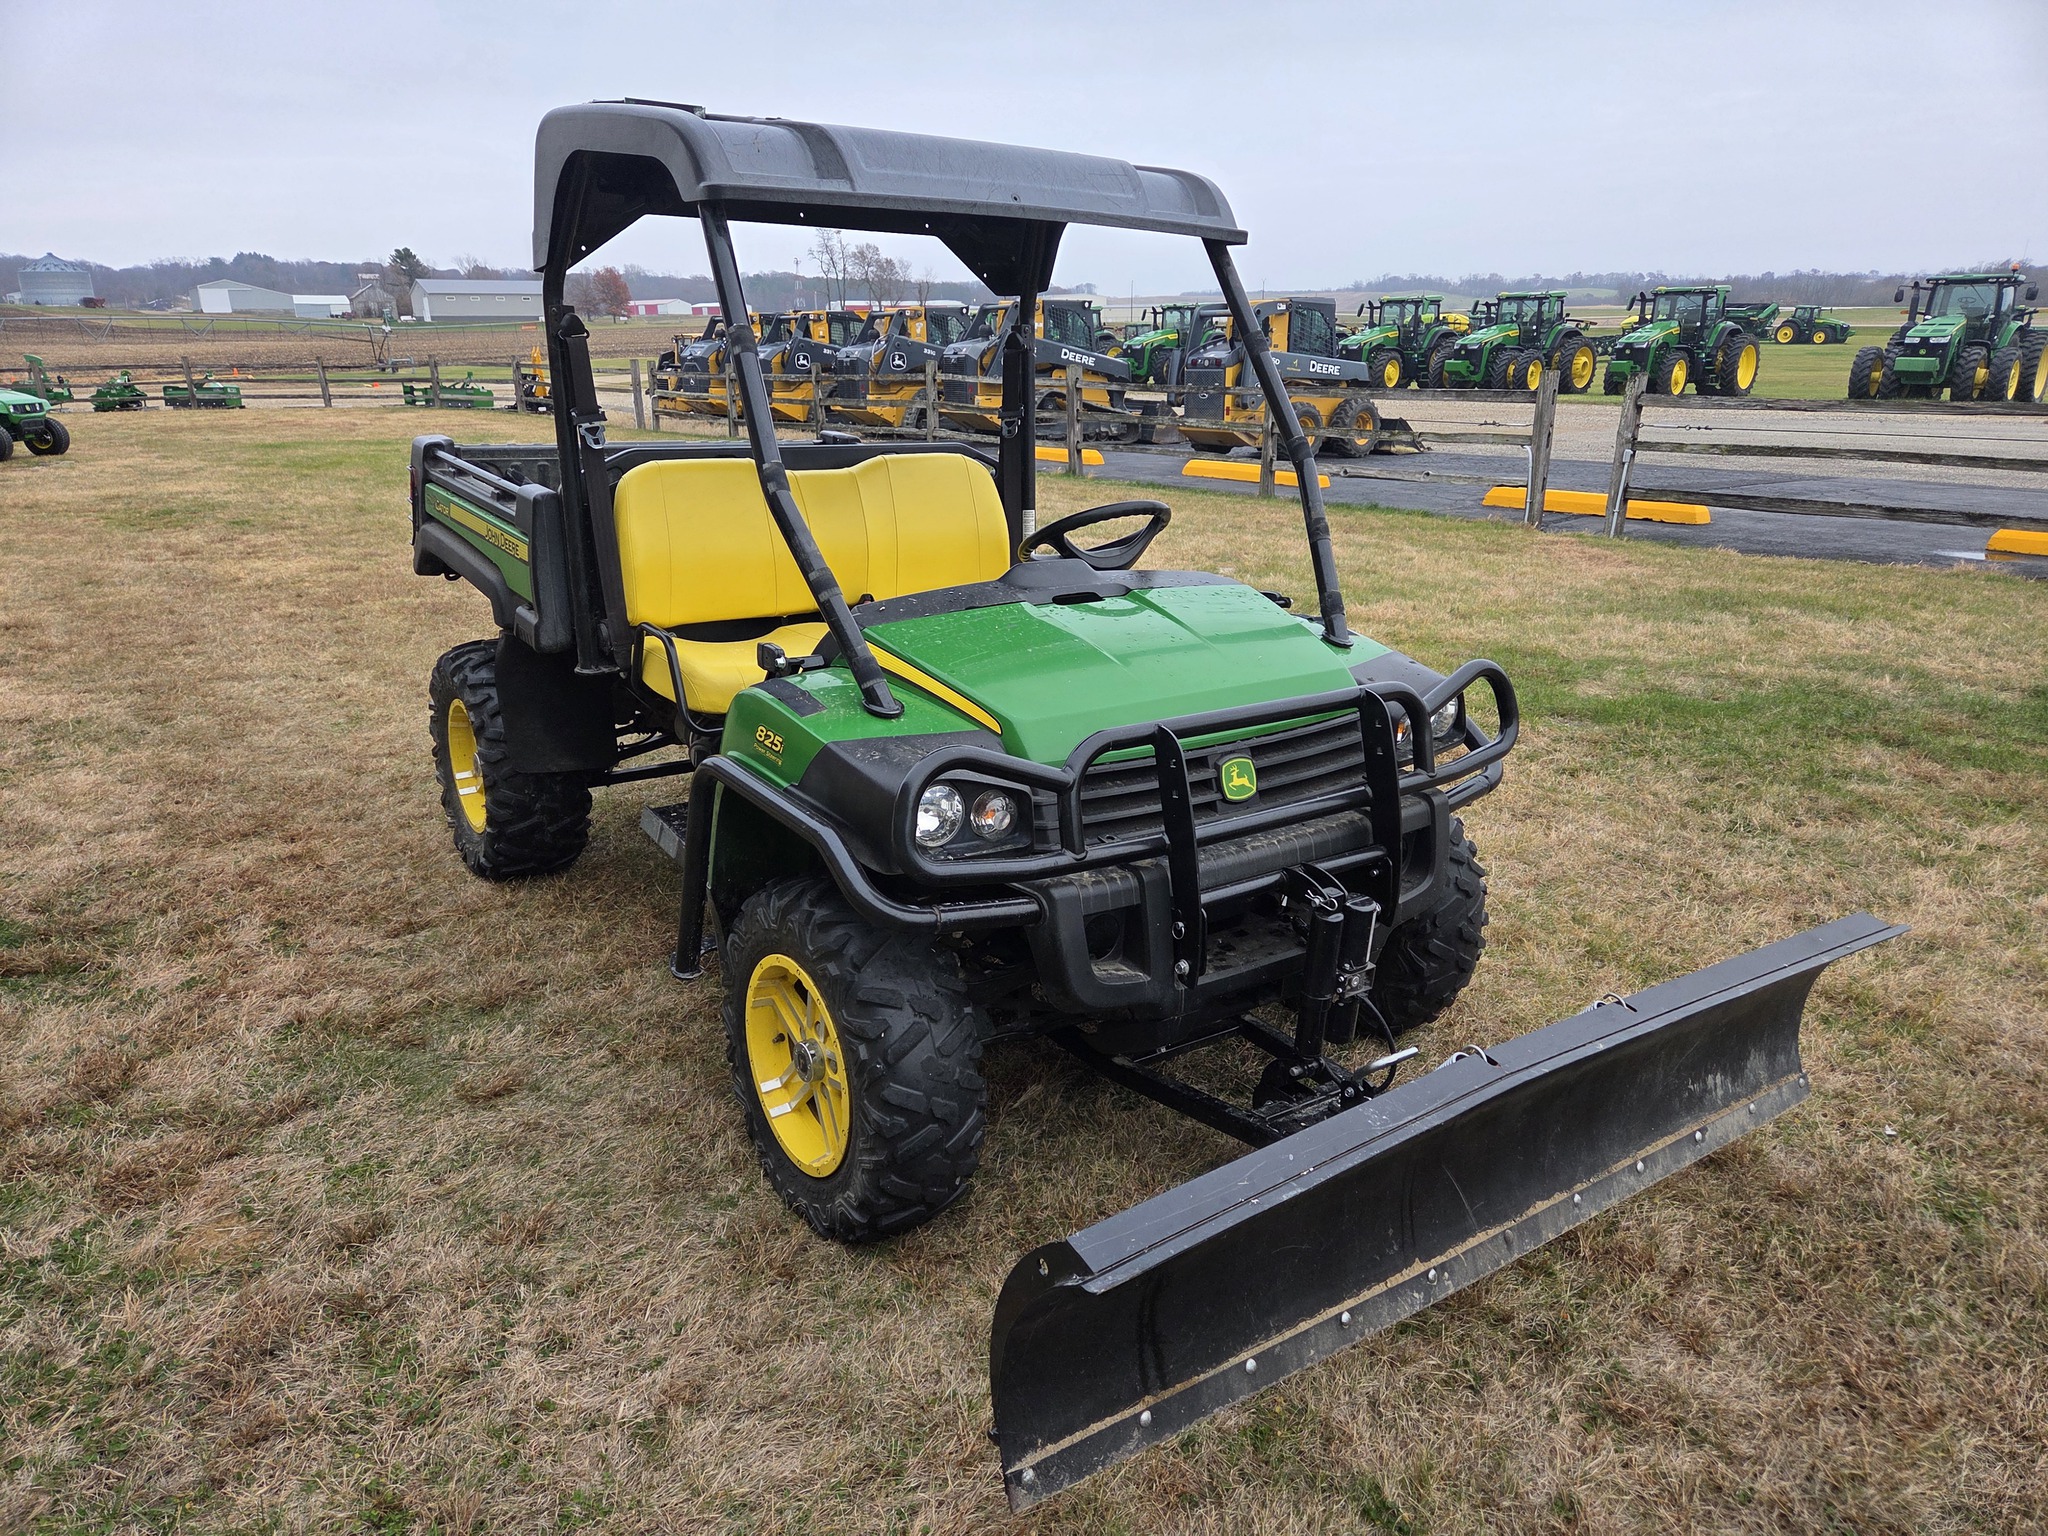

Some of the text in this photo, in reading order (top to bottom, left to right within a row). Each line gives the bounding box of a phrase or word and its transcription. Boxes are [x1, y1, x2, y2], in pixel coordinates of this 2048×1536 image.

[1061, 348, 1096, 366] DEERE
[1309, 360, 1341, 376] DEERE
[485, 524, 520, 558] JOHN DEERE
[755, 725, 784, 754] 825i
[753, 742, 783, 766] Power Steering
